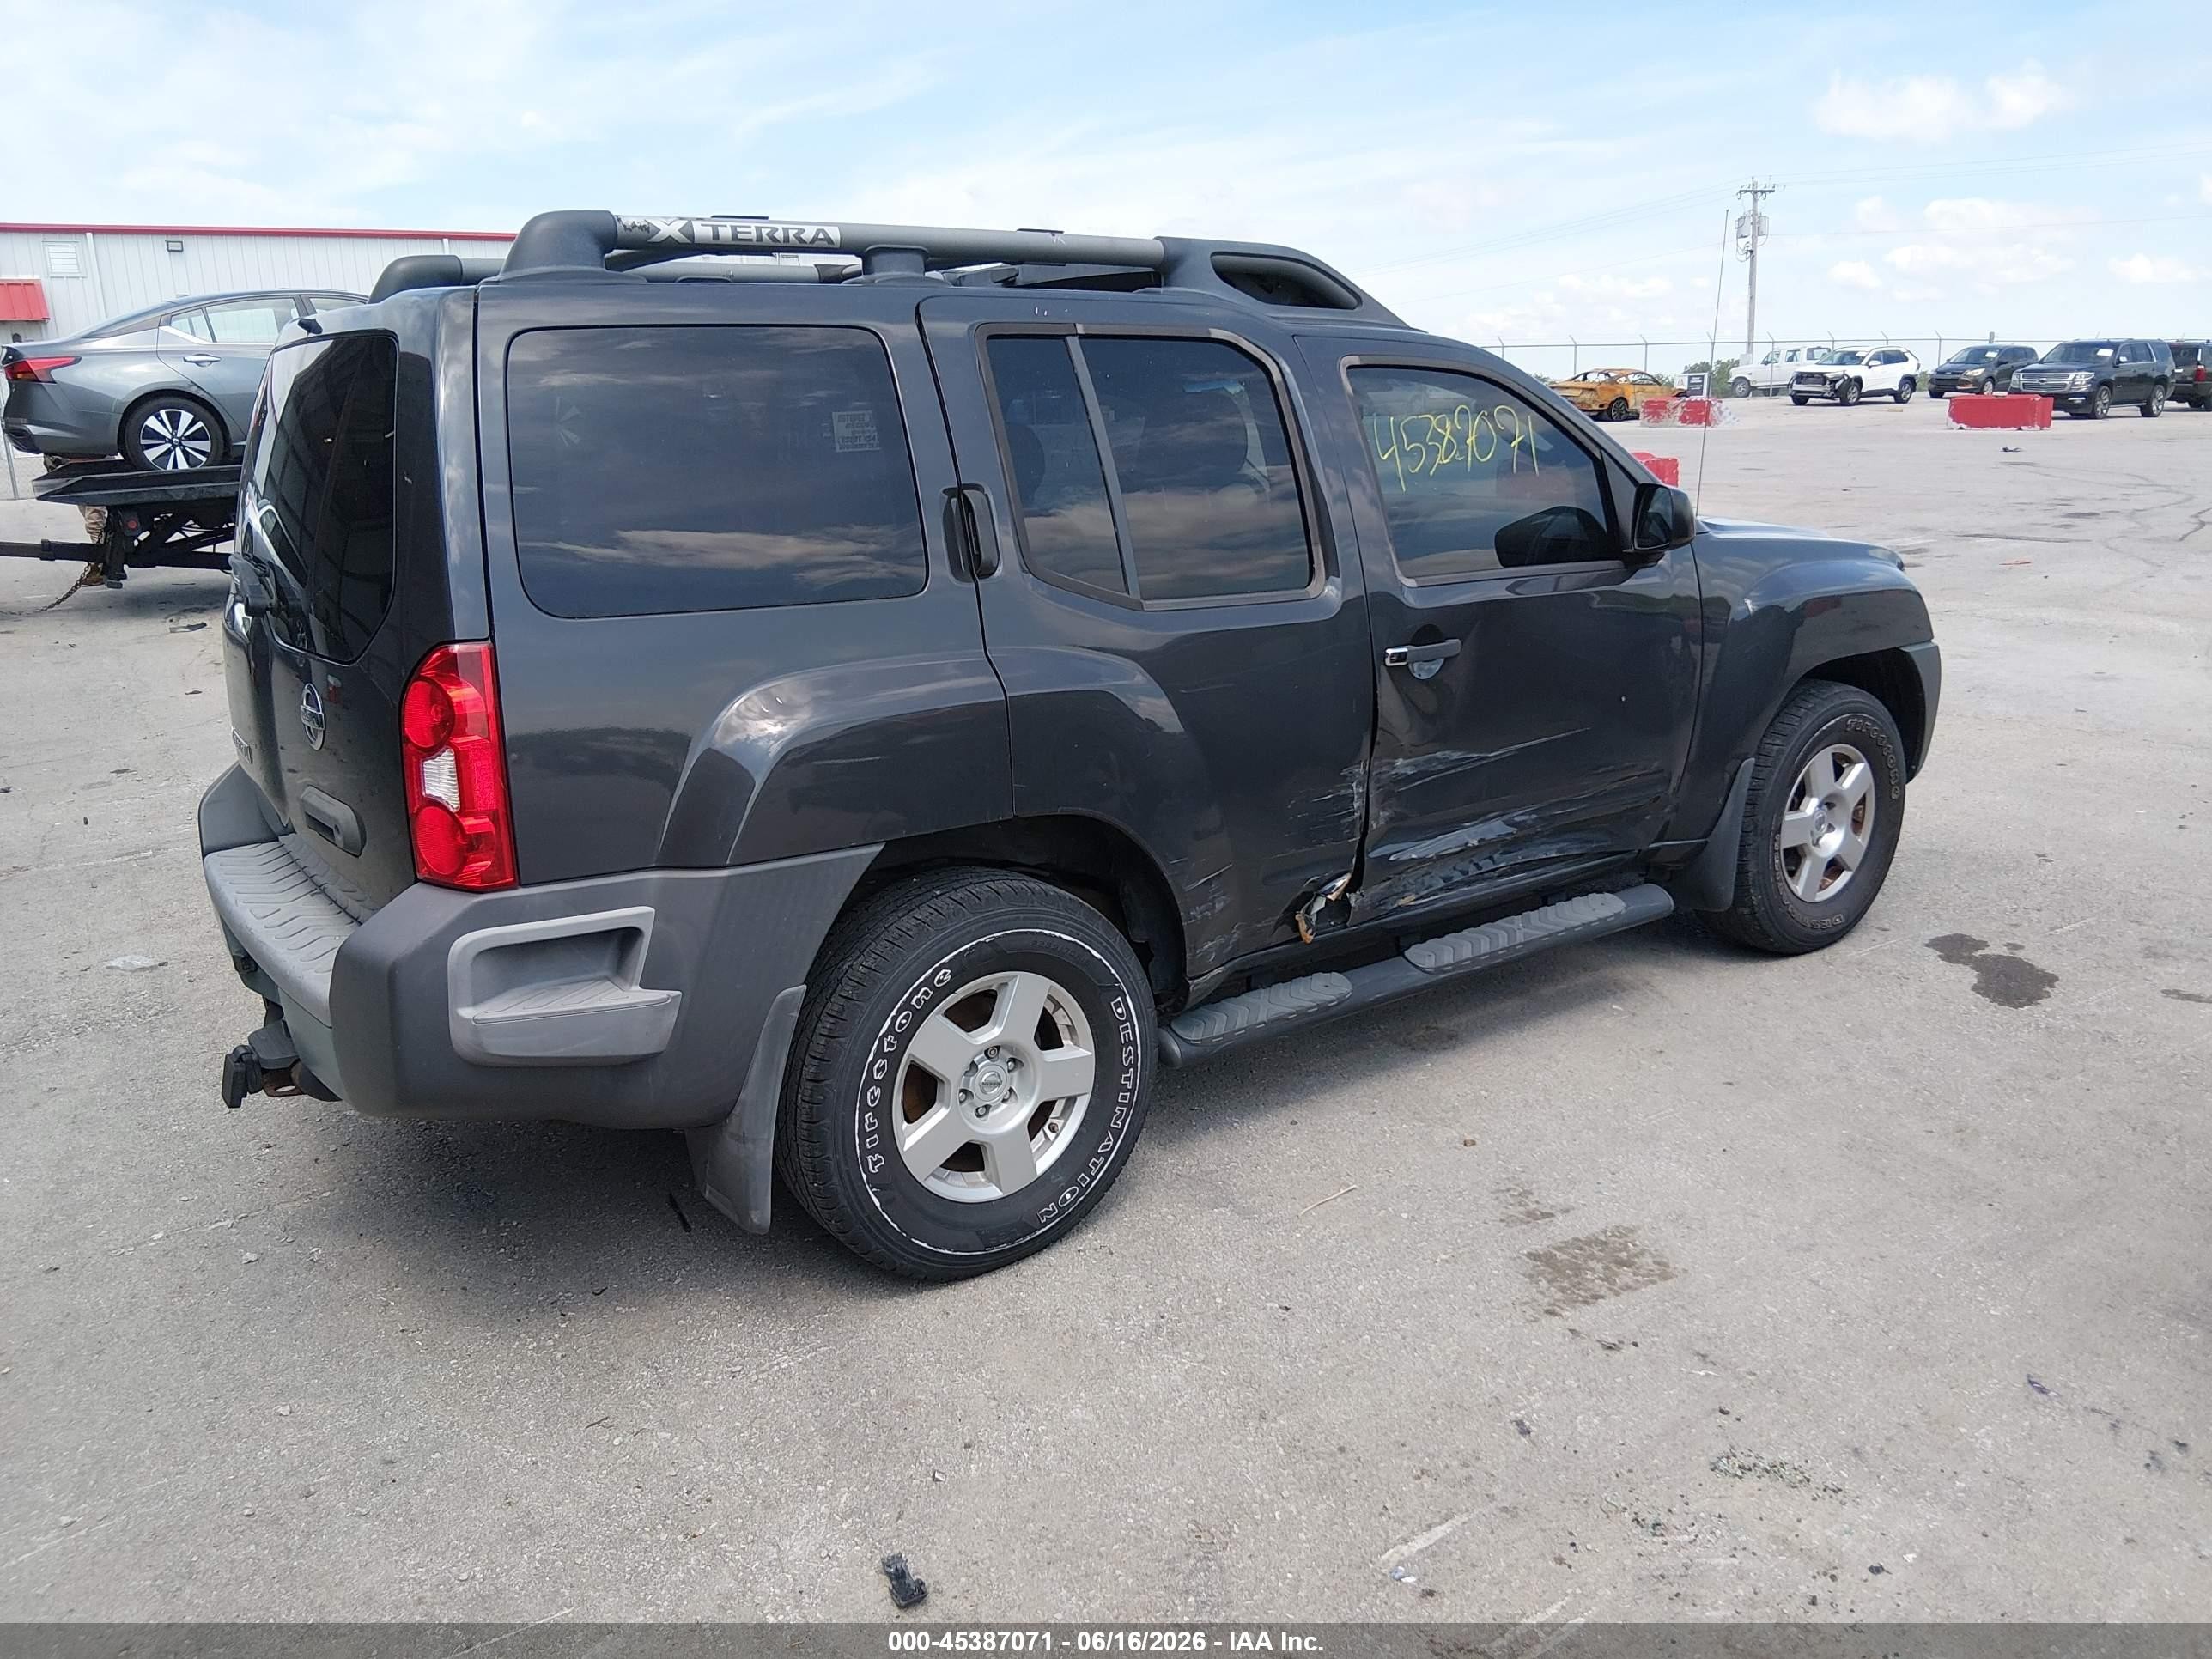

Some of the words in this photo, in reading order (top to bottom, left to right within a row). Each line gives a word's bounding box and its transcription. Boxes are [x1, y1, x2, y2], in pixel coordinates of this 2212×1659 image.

[1373, 404, 1540, 493] 45387071
[864, 969, 951, 1174] Firestone
[1036, 996, 1134, 1224] DESTINATION
